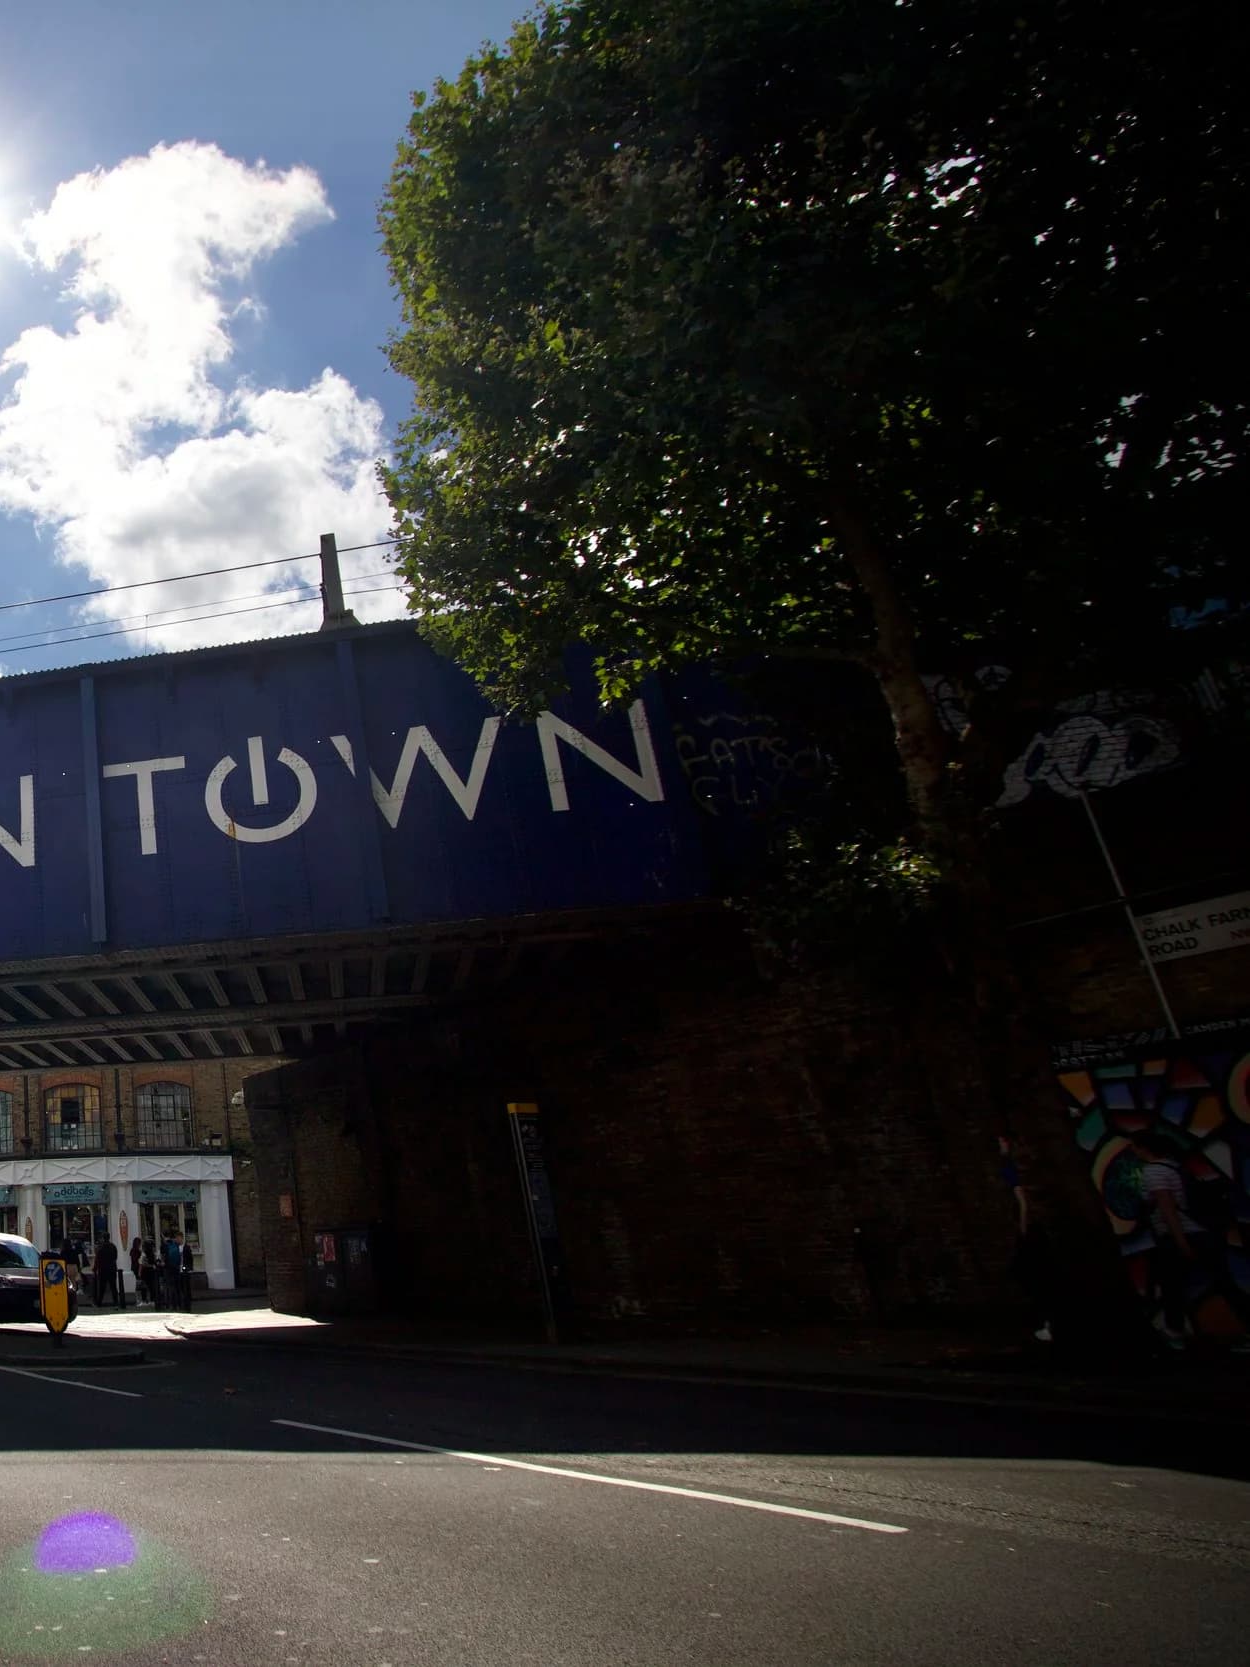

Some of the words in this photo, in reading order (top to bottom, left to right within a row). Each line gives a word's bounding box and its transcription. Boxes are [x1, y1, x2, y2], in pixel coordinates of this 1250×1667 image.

[102, 699, 665, 855] TOWN
[1144, 917, 1202, 940] CHALK
[1148, 936, 1198, 956] ROAD
